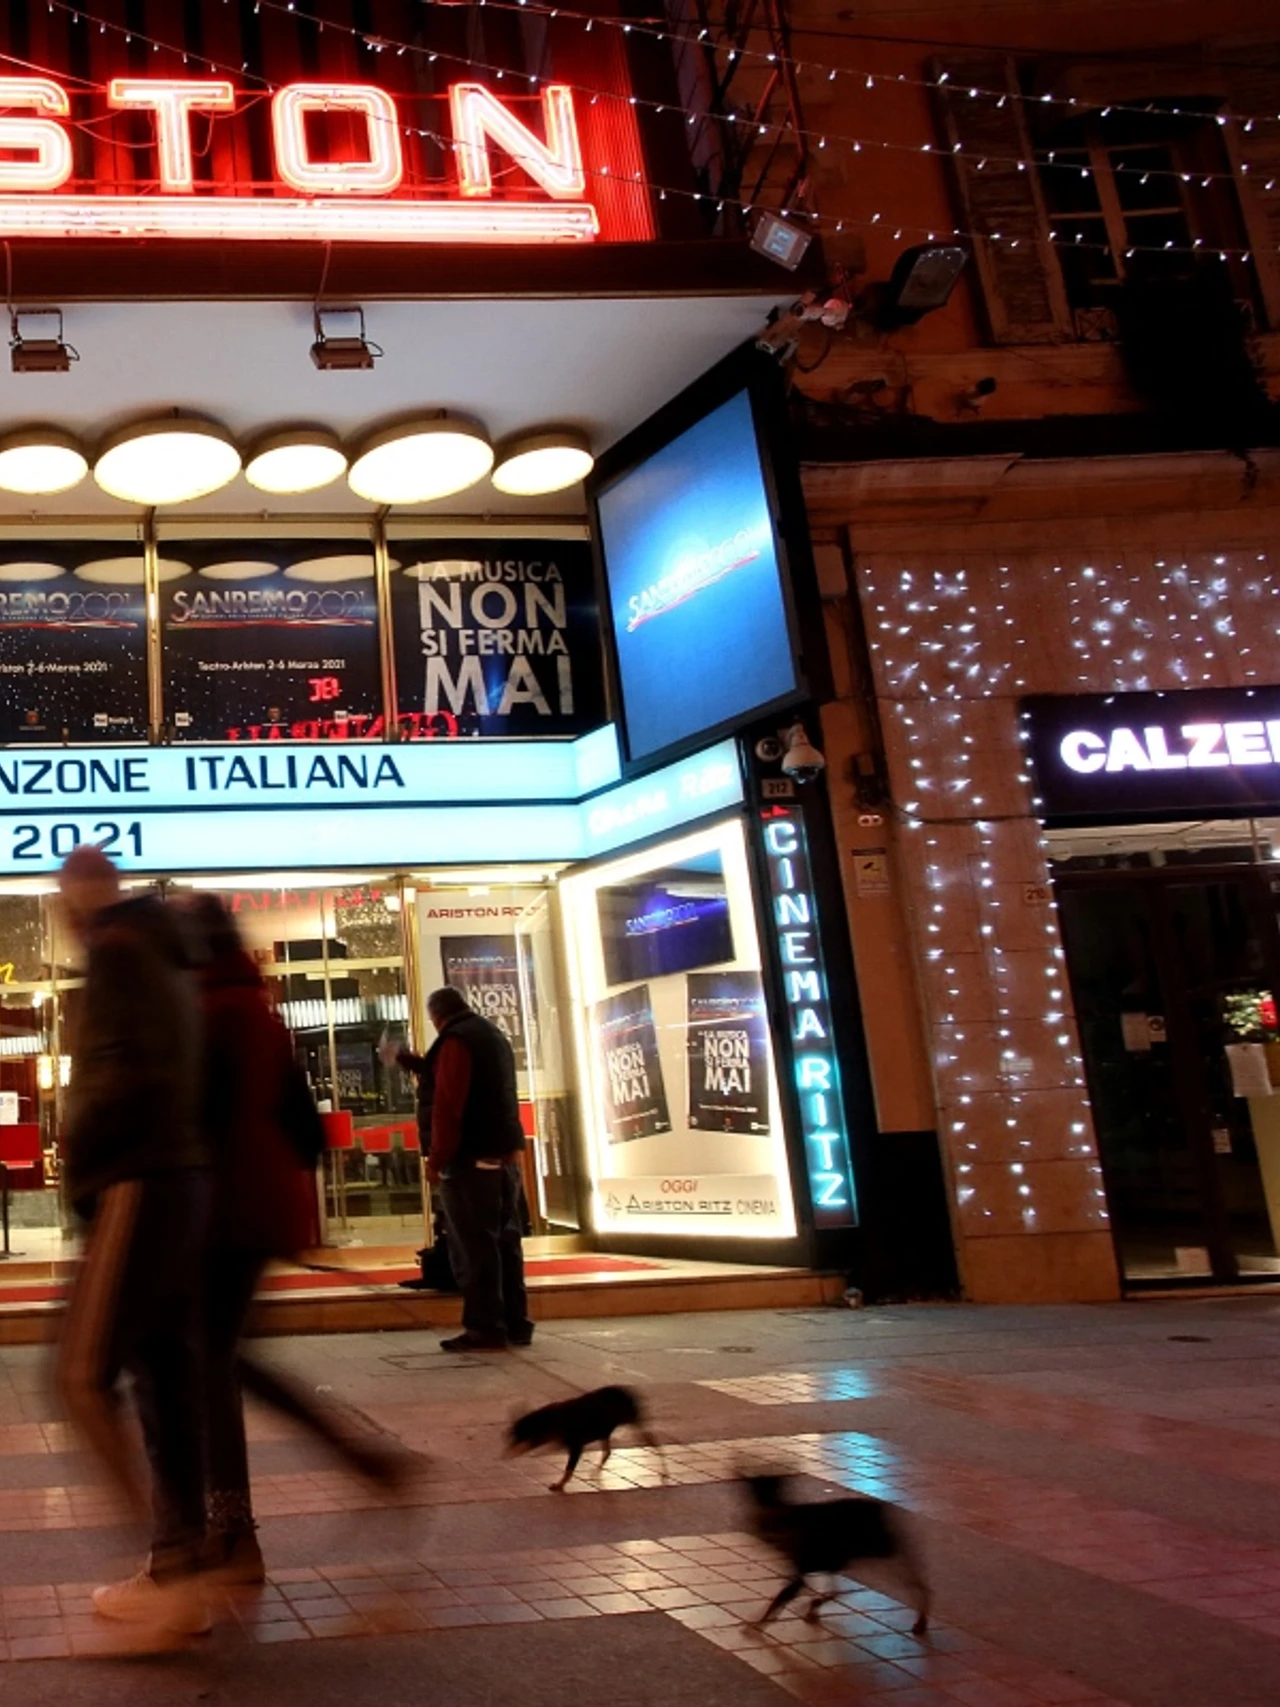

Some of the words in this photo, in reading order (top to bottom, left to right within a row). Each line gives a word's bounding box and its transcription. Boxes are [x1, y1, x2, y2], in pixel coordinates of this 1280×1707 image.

[418, 561, 450, 581] LA
[461, 561, 562, 581] MUSICA
[418, 582, 567, 629] NON
[421, 630, 448, 656] SI
[459, 629, 569, 655] FERMA
[424, 655, 574, 715] MAI
[1060, 718, 1280, 773] CALZE
[185, 754, 406, 792] ITALIANA
[12, 821, 144, 860] 2021
[426, 907, 499, 919] ARISTON
[766, 822, 826, 1041] CINEMA
[467, 991, 518, 1008] NON
[606, 1050, 645, 1071] NON
[704, 1038, 750, 1057] NON
[612, 1075, 651, 1106] MAI
[704, 1067, 752, 1093] MAI
[799, 1057, 847, 1206] RITZ
[660, 1180, 699, 1193] OGGI
[625, 1194, 695, 1214] ARISTON
[699, 1200, 732, 1211] RITZ
[736, 1200, 777, 1215] CINEMA
